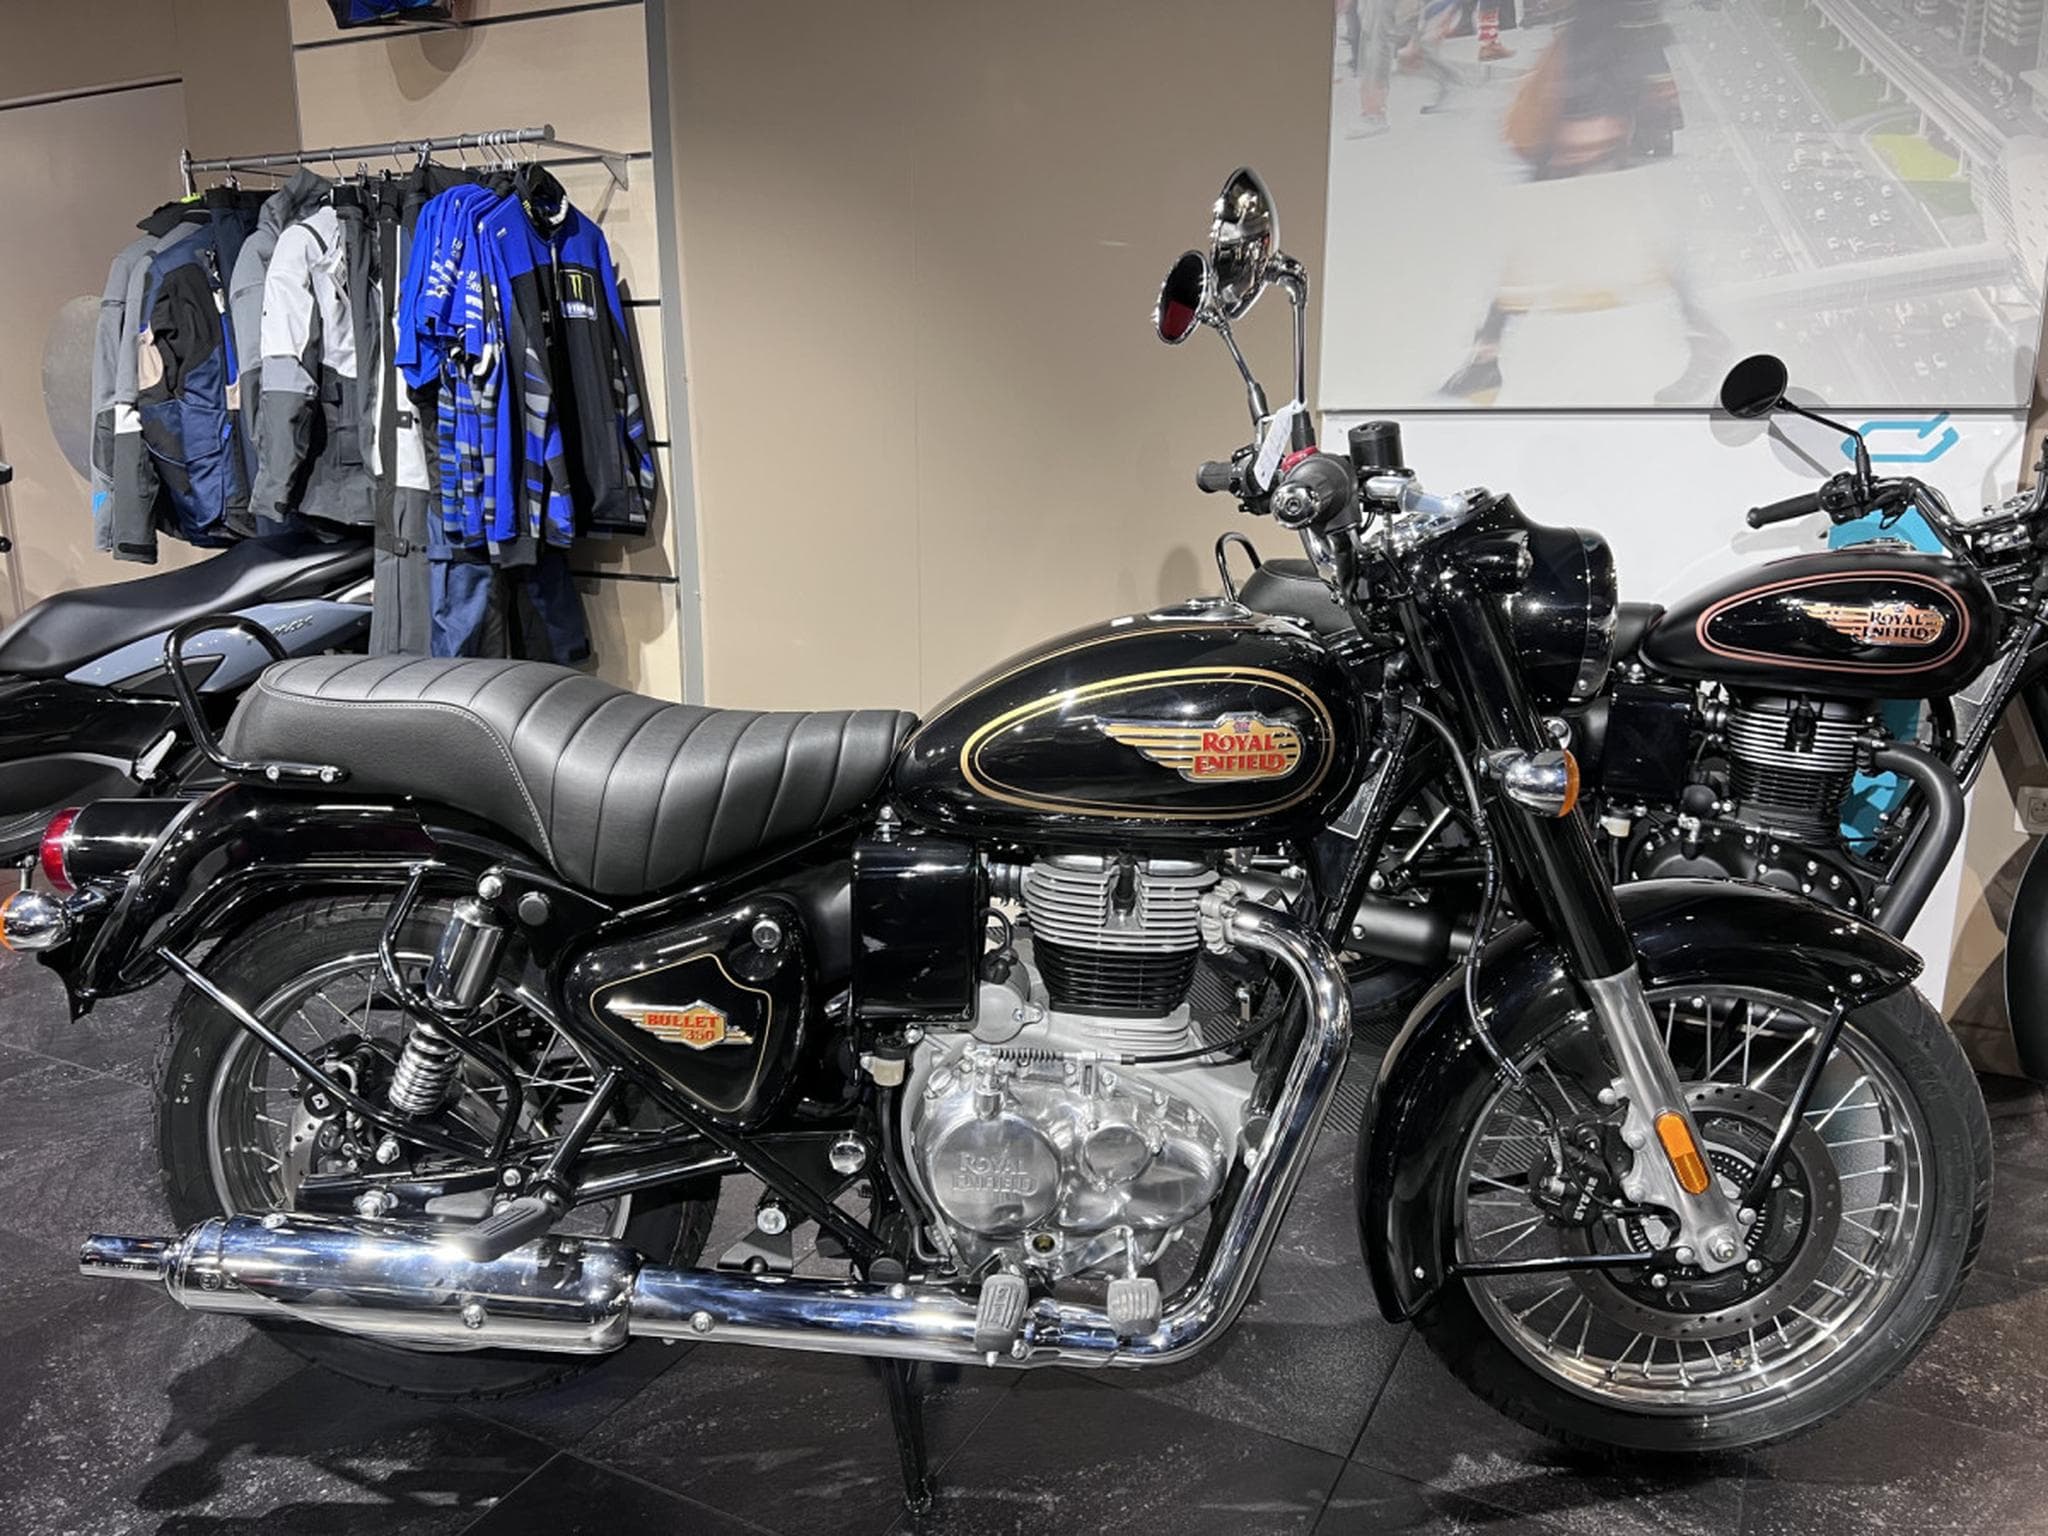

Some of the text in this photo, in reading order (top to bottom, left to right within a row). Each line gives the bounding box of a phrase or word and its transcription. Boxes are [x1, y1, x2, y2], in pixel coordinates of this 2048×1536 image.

[1869, 611, 1923, 626] ROYAL
[1202, 732, 1279, 754] ROYAL
[1194, 753, 1286, 775] ENFIELD
[647, 1014, 720, 1028] BULLET
[686, 1029, 715, 1041] 350
[959, 1151, 1029, 1176] ROYAL
